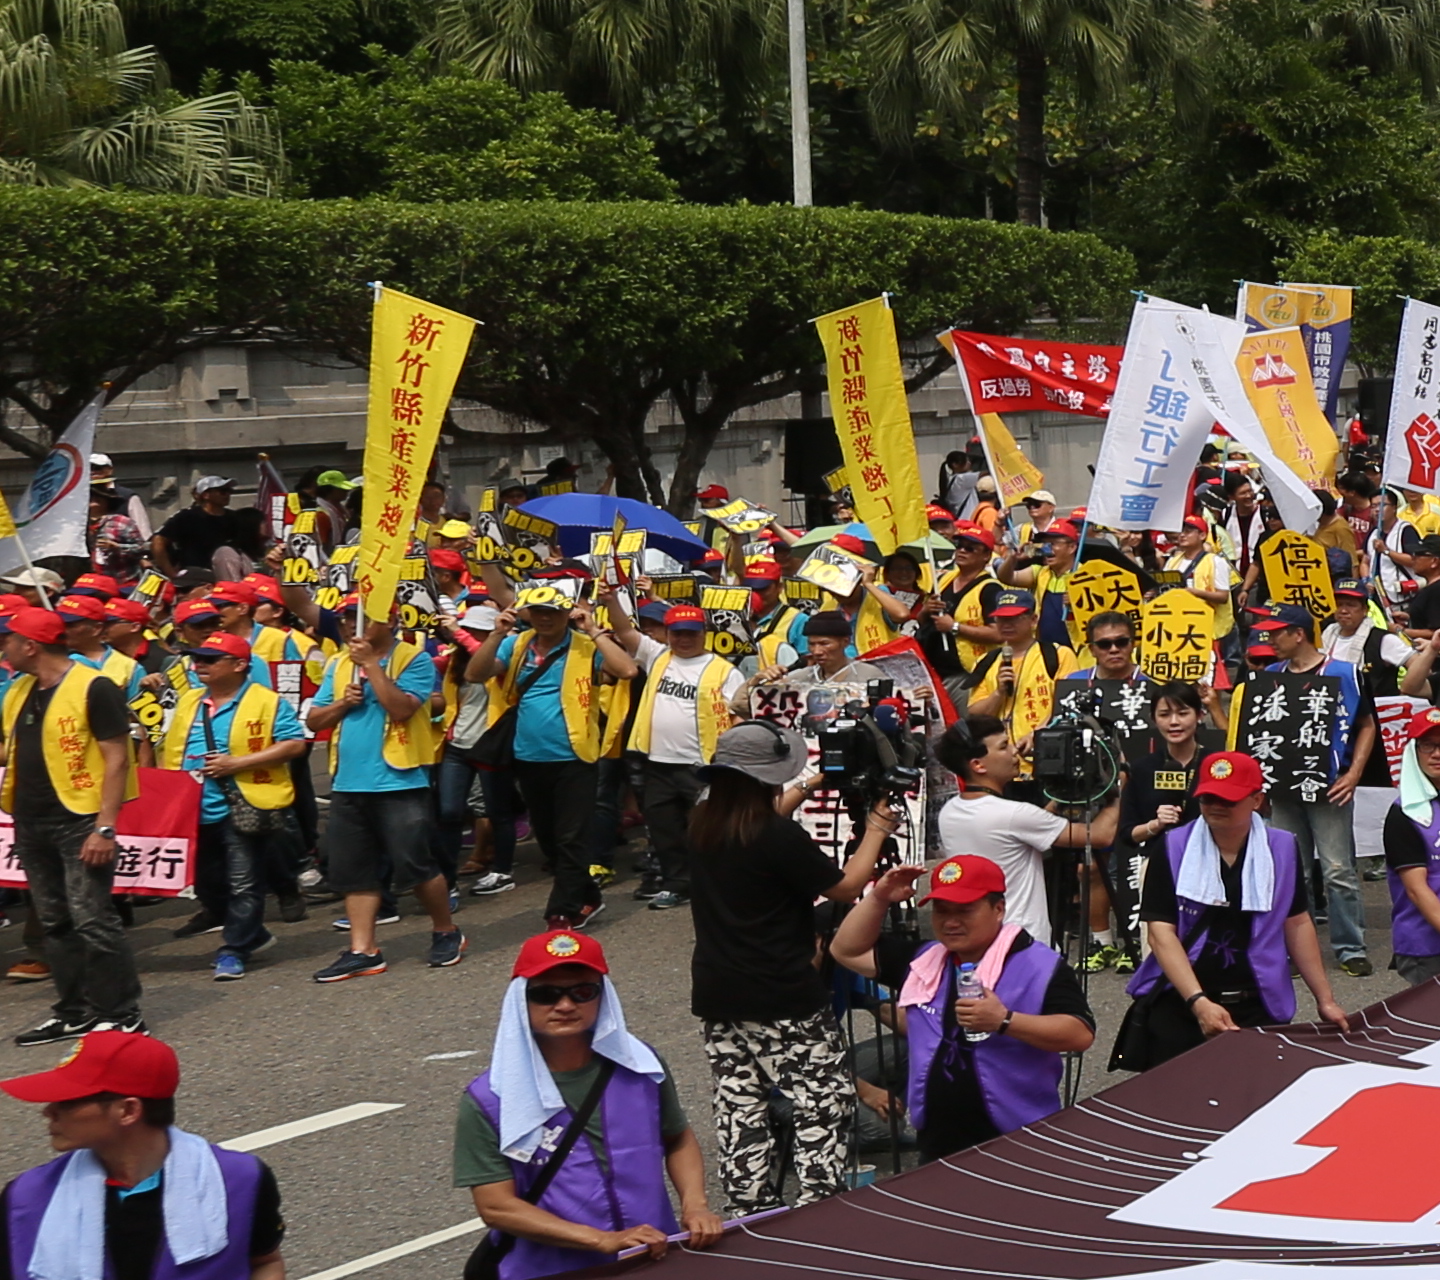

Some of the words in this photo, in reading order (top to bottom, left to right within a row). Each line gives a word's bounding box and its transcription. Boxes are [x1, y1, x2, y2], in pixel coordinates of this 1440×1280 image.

[981, 379, 1032, 399] 反過勞
[1270, 537, 1332, 617] 停飛
[701, 588, 750, 611] 加薪
[399, 608, 438, 630] 0%
[704, 631, 754, 655] 10%
